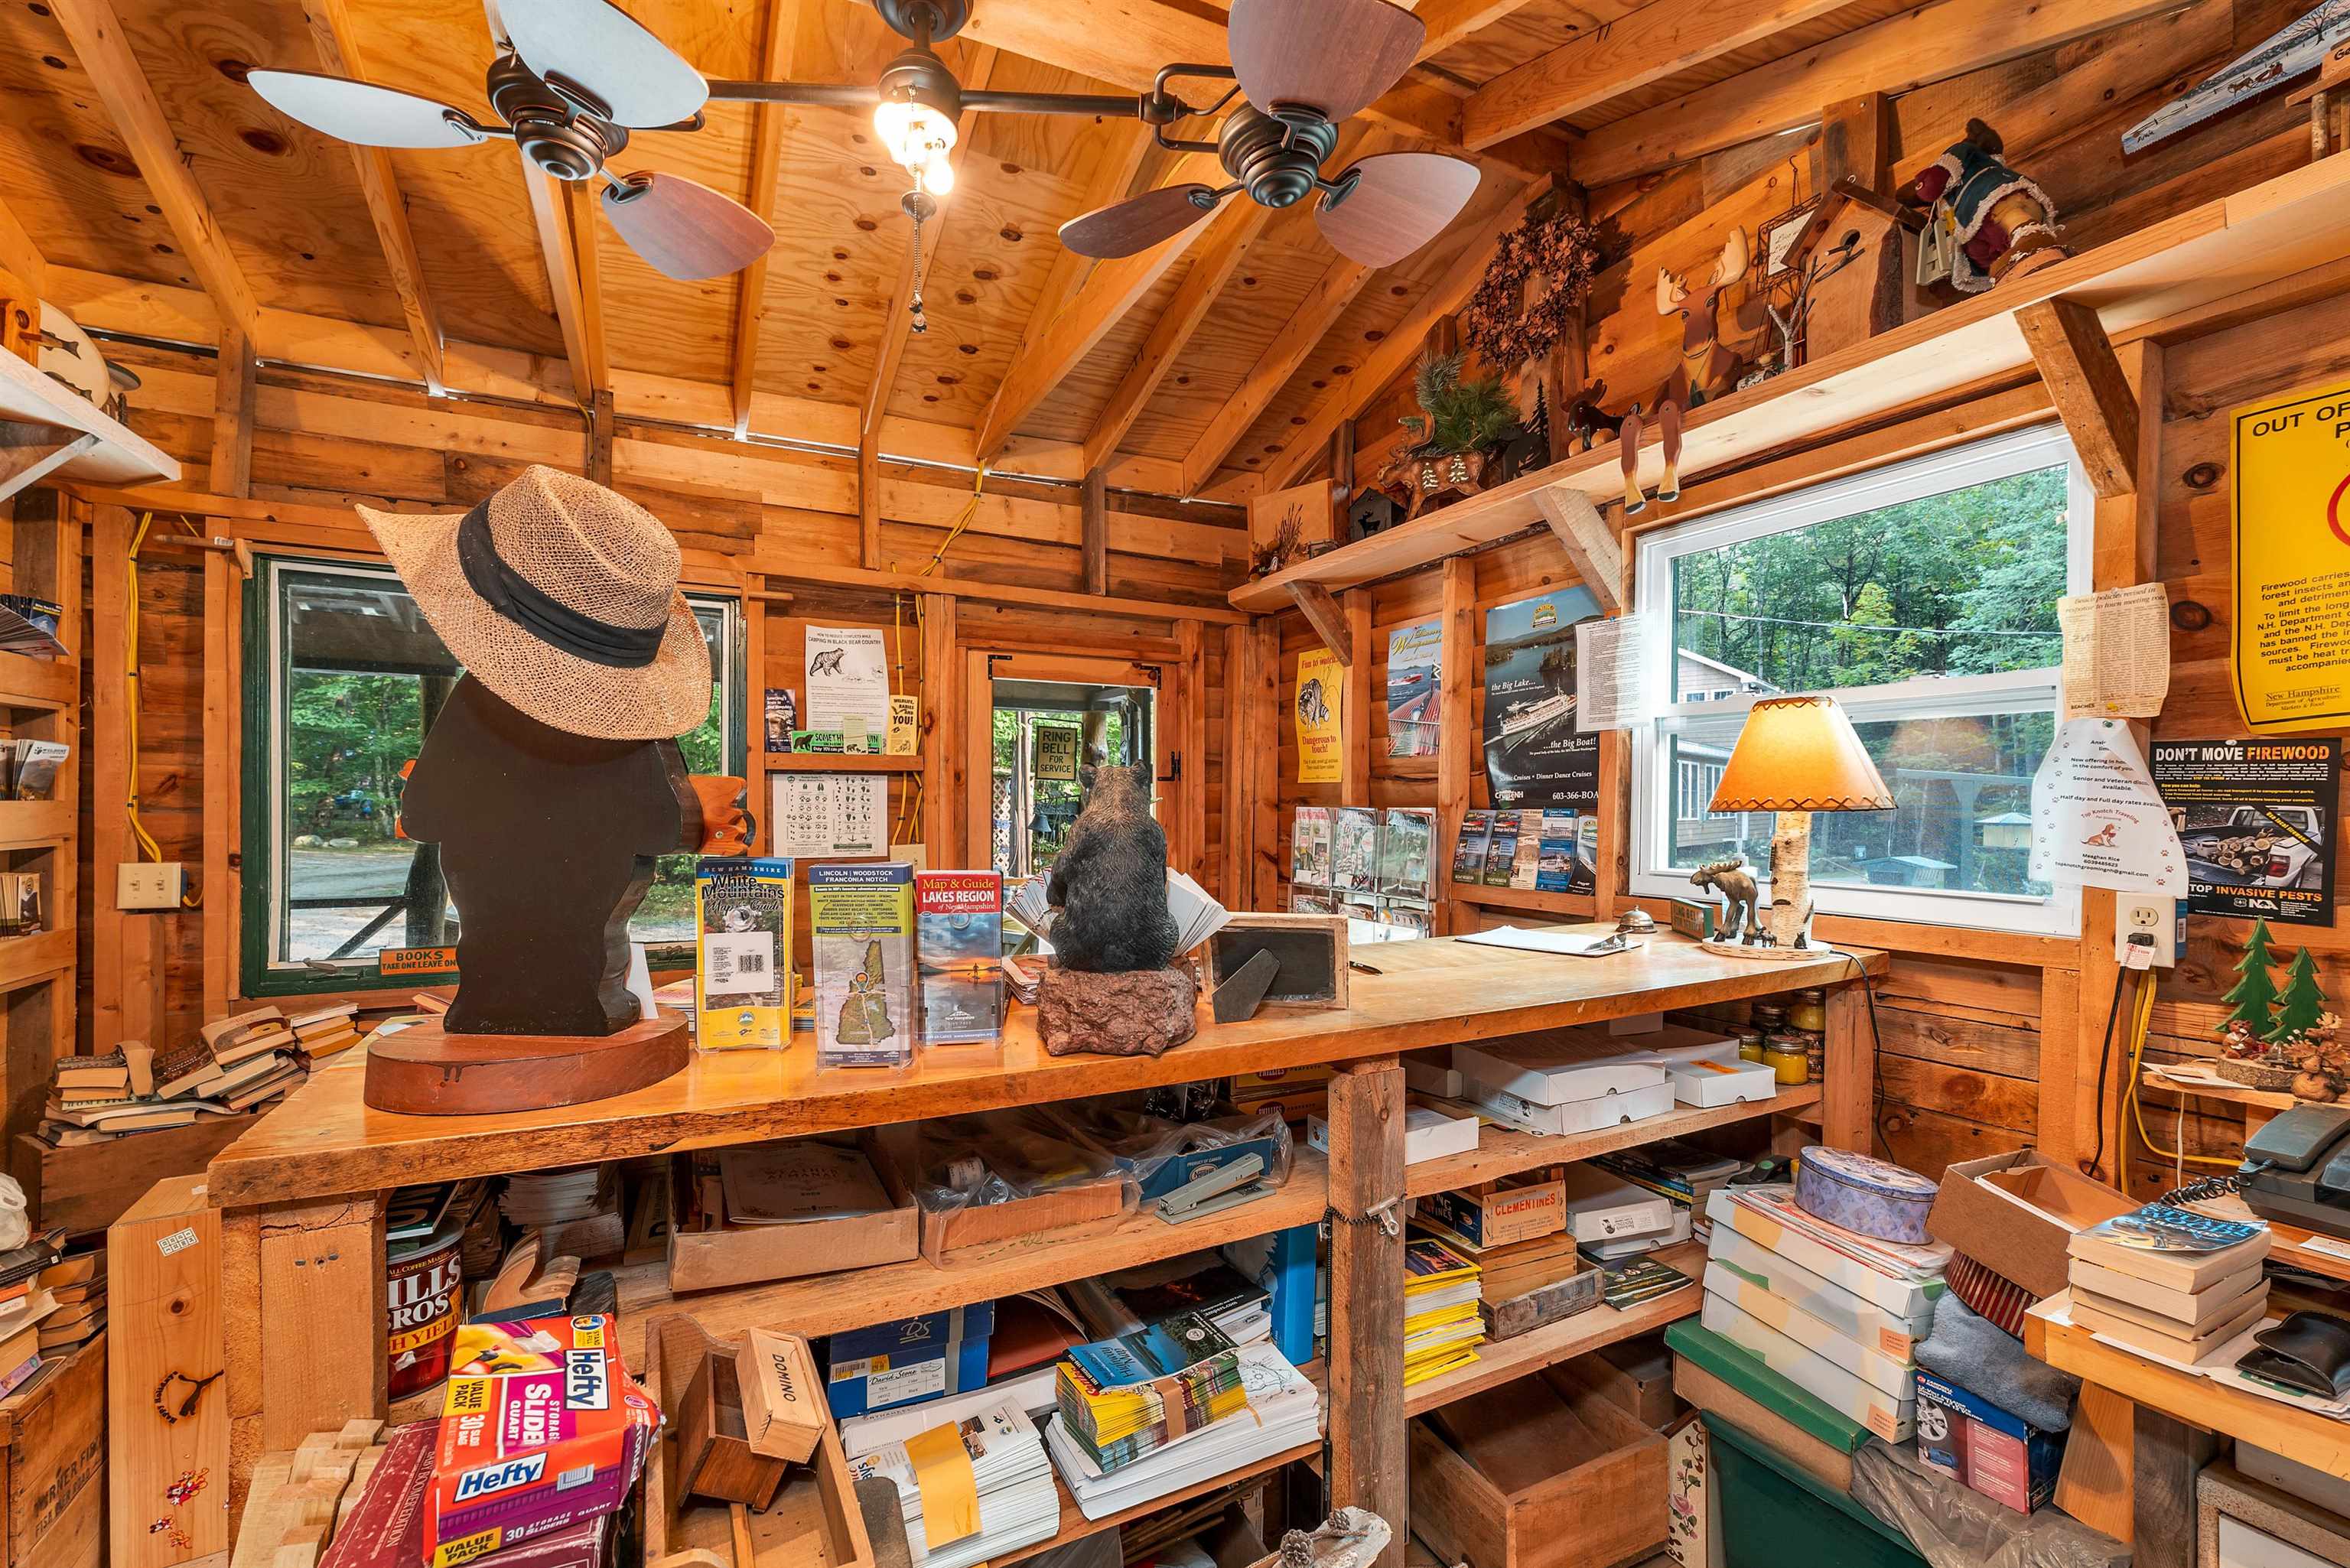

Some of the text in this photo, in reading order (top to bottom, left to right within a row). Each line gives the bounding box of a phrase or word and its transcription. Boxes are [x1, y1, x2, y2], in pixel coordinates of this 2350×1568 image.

[2253, 402, 2350, 436] OUT OF
[2261, 571, 2350, 592] Firewood carries
[2096, 592, 2122, 603] policies
[2124, 587, 2147, 597] revised
[2261, 583, 2333, 601] forest insects
[2104, 600, 2122, 609] town
[2124, 597, 2150, 606] meeting
[2278, 598, 2296, 607] and
[2279, 608, 2300, 617] limit
[2305, 605, 2321, 613] the
[2257, 612, 2342, 631] N.H. Department
[2260, 630, 2339, 648] has banned the
[2264, 623, 2326, 639] and the N.H.
[2260, 647, 2301, 658] sources.
[2269, 649, 2335, 665] must be heat
[1301, 661, 1312, 669] Fun
[1502, 681, 1513, 690] Big
[1514, 679, 1536, 688] Lake...
[2266, 685, 2341, 701] New Hampshire
[2266, 699, 2296, 708] Department
[893, 715, 913, 725] YOU!
[1042, 730, 1071, 743] RING
[1302, 736, 1330, 747] Dangerous
[1563, 737, 1597, 750] Big Boat!
[1042, 743, 1070, 754] BELL
[1311, 743, 1329, 753] touch!
[2156, 745, 2329, 761] DON'T MOVE FIREWOOD
[1049, 755, 1063, 763] FOR
[1040, 764, 1072, 773] SERVICE
[1552, 791, 1599, 800] 603-366-BOA
[2114, 809, 2140, 825] Traveling
[2081, 852, 2107, 860] Meaghan
[710, 873, 757, 887] White
[923, 878, 995, 891] Map & Guide
[701, 886, 785, 899] Mountains
[923, 890, 994, 903] LAKES REGION
[2189, 883, 2323, 903] TOP INVASIVE PESTS
[705, 899, 780, 916] Map Guide
[396, 951, 444, 961] BOOKS
[1495, 1192, 1555, 1217] CLEMENTINES
[389, 1251, 450, 1275] ALL COFFEE MAKERS
[387, 1254, 461, 1309] ILLS
[412, 1313, 459, 1344] YIELD
[1114, 1347, 1134, 1365] Map
[566, 1352, 602, 1407] Hefty
[770, 1353, 796, 1403] DOMINO
[869, 1370, 917, 1385] David Stone
[154, 1371, 178, 1404] Holidays
[467, 1380, 485, 1409] VALUE
[453, 1384, 470, 1409] PACK
[157, 1405, 177, 1424] Happy
[459, 1414, 485, 1430] 30
[507, 1400, 520, 1440] QUART
[461, 1462, 540, 1495] Hefty
[387, 1450, 435, 1548] BABY BOOMER EDITION
[506, 1511, 573, 1541] 30 STORAGE
[526, 1501, 611, 1536] SLIDERS QUART
[444, 1534, 494, 1554] VALUE
[448, 1543, 490, 1561] PACK
